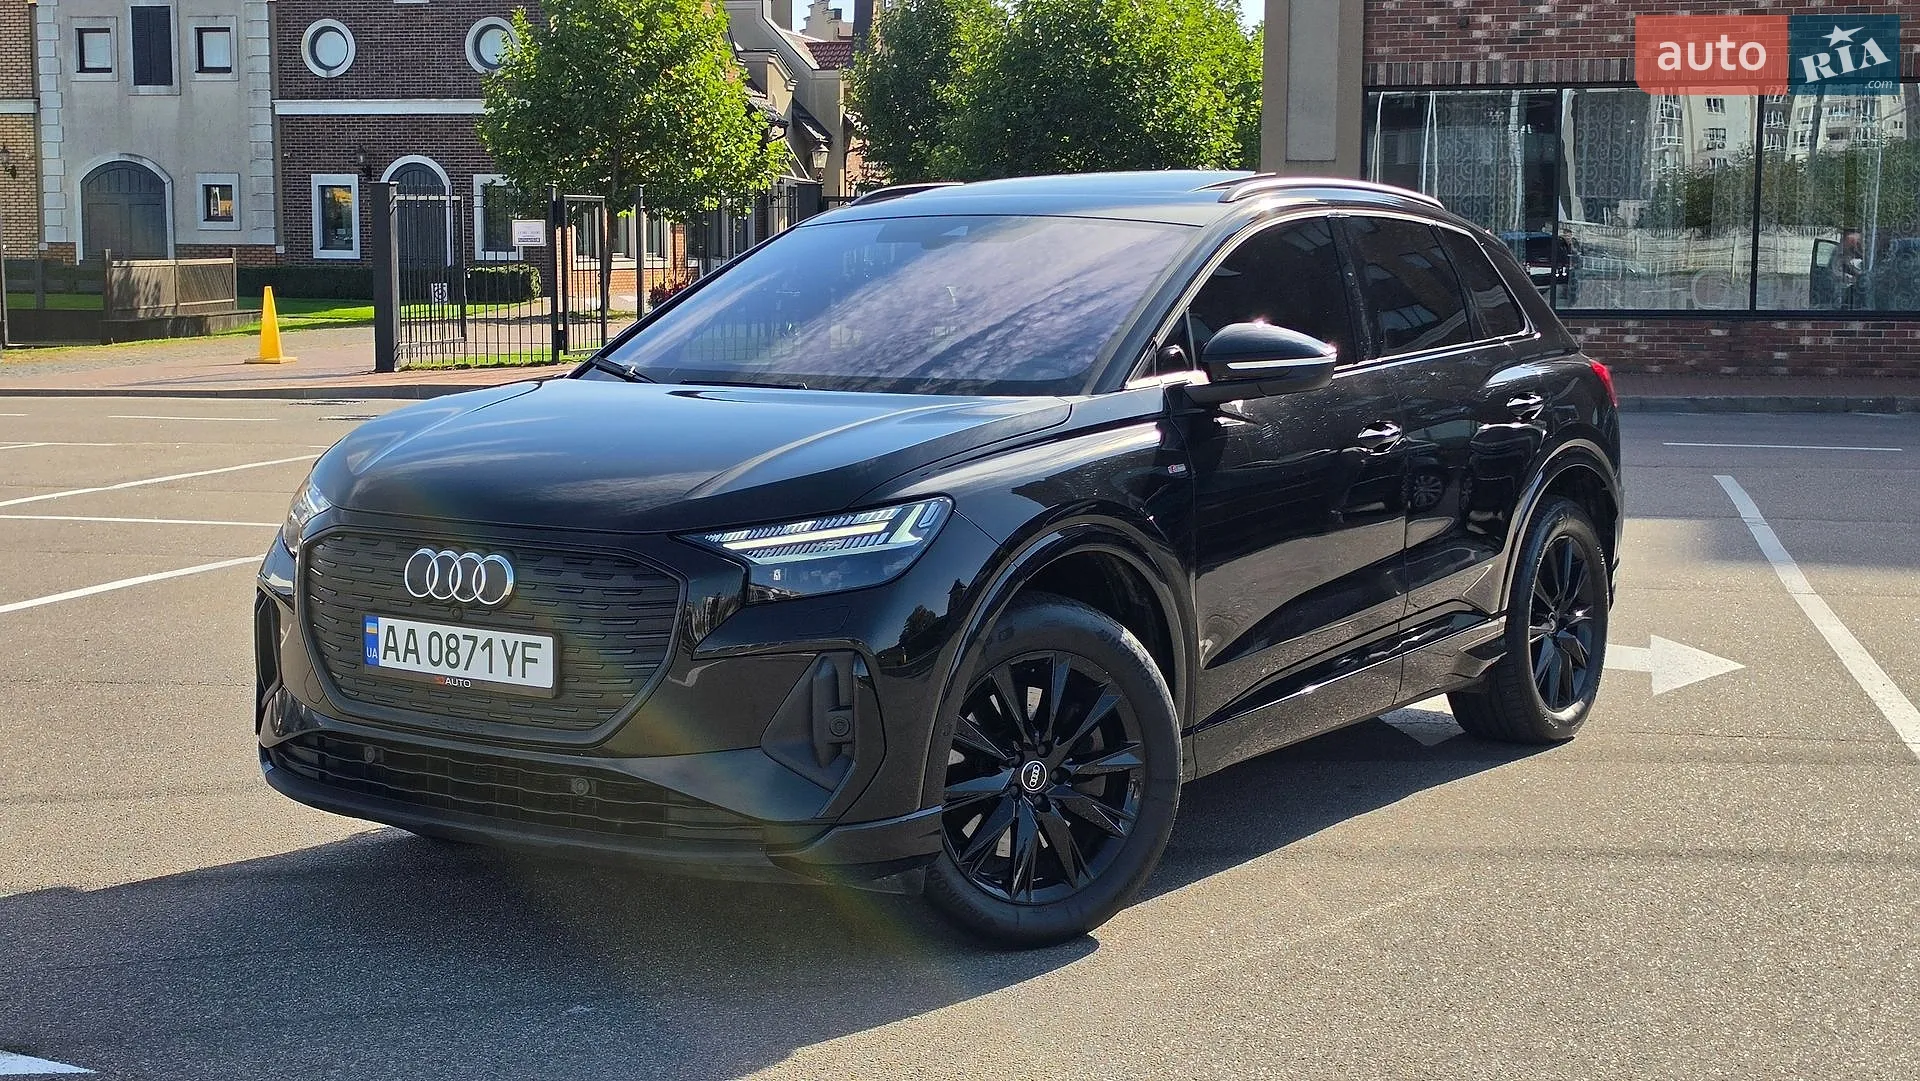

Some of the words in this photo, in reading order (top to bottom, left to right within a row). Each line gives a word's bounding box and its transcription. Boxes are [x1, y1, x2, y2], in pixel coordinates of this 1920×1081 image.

[366, 646, 378, 659] UA
[382, 625, 421, 665] AA
[428, 630, 494, 674] 0871
[501, 639, 542, 678] YF
